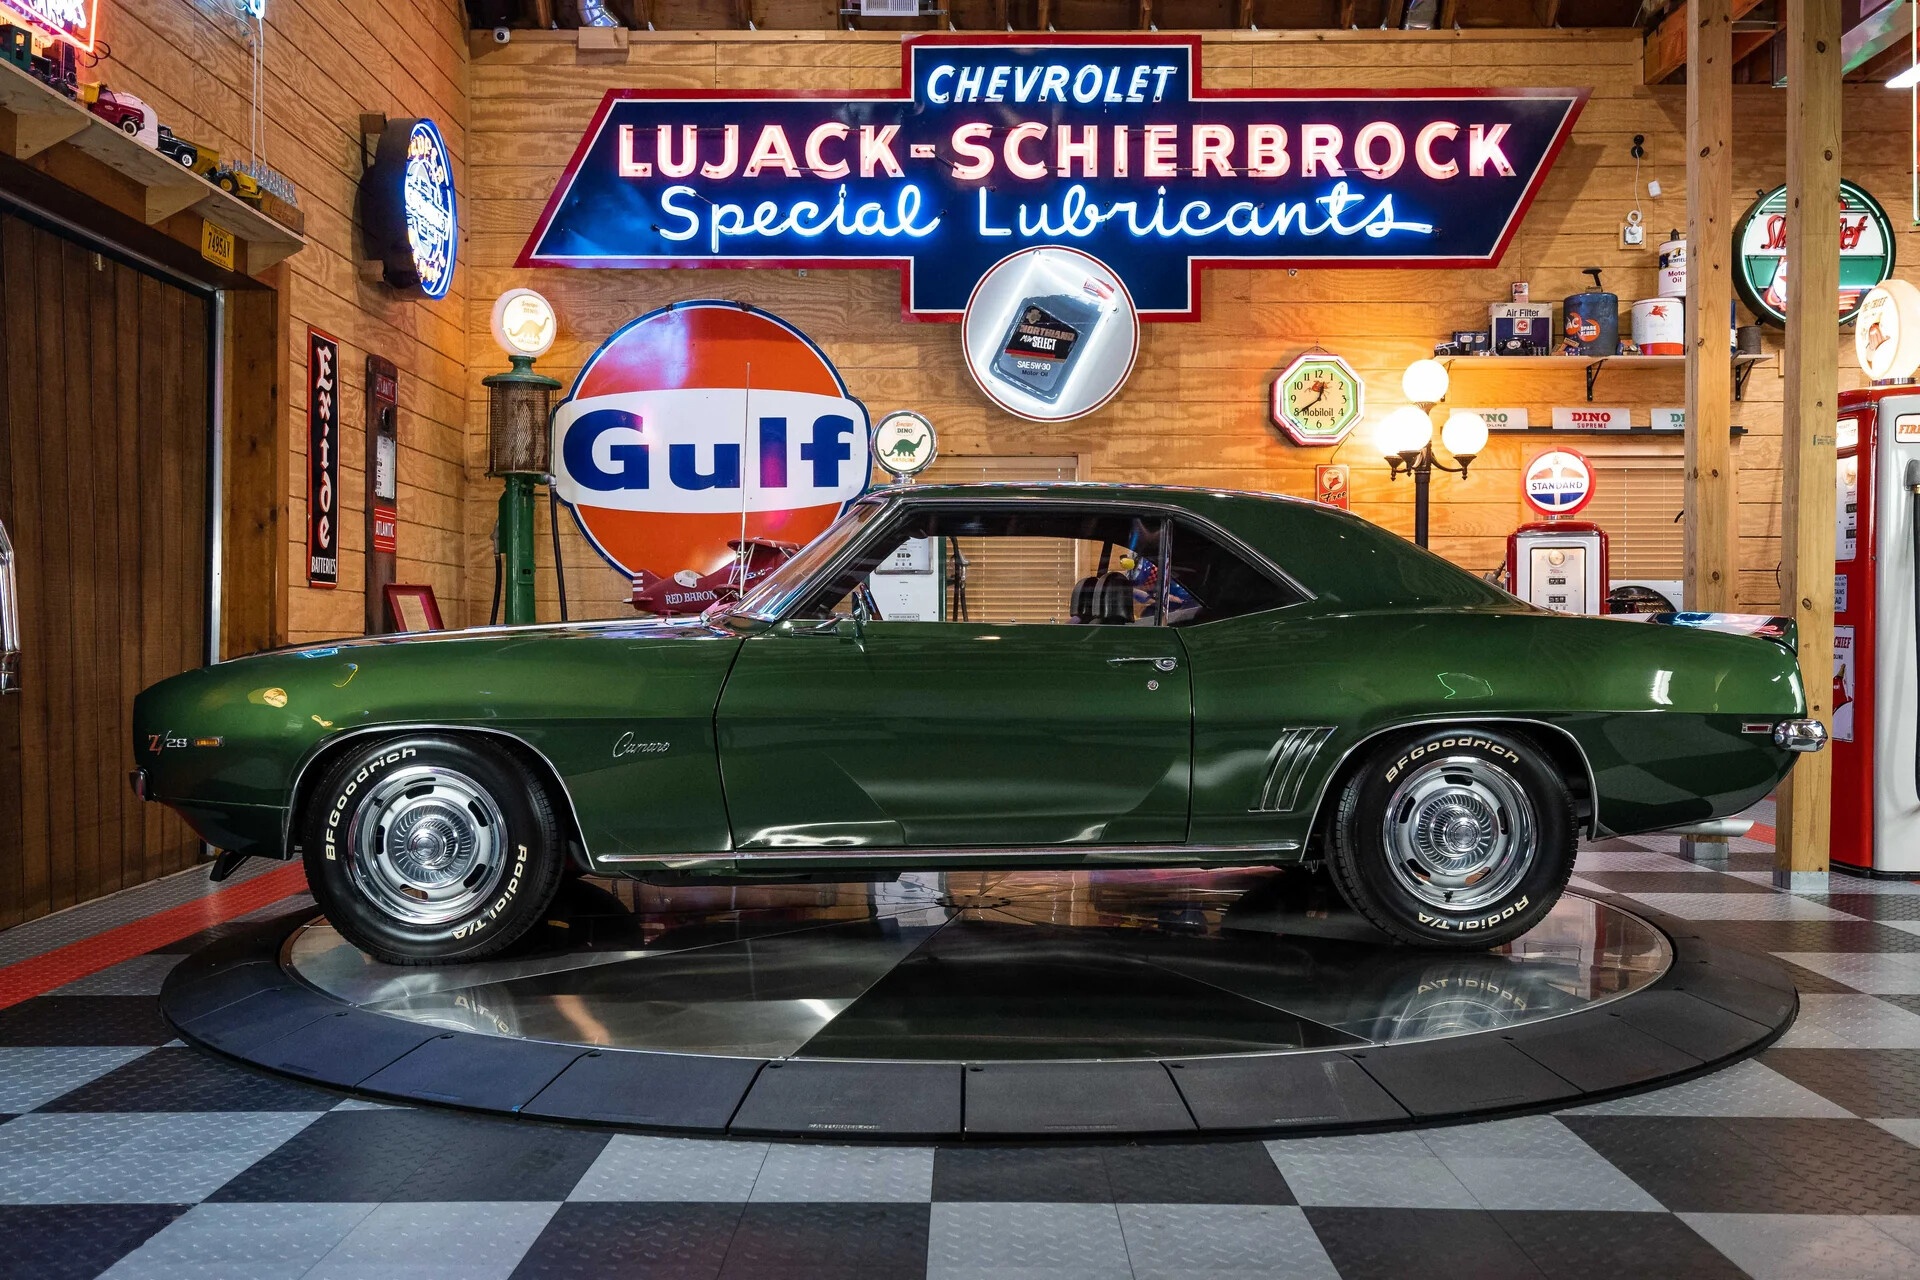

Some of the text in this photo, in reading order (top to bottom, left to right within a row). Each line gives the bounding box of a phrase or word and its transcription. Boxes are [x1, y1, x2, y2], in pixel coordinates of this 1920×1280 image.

[926, 63, 1178, 103] CHEVROLET
[617, 121, 1517, 181] LUJACK-SCHIERBROCK
[658, 181, 1433, 254] Special Lubricants
[1506, 308, 1539, 317] Air Filter
[1566, 317, 1579, 330] AC
[1019, 324, 1075, 341] NORTHLAND
[1017, 360, 1030, 369] SAE
[1304, 373, 1310, 381] 11
[1315, 370, 1323, 378] 12
[1294, 381, 1303, 390] 10
[1339, 381, 1344, 390] 2
[1290, 395, 1297, 403] 9
[1341, 395, 1347, 404] 3
[1294, 408, 1300, 416] 8
[1302, 408, 1334, 416] Mobiloil
[1338, 408, 1344, 416] 4
[1571, 412, 1611, 422] DINO
[1303, 418, 1309, 426] 7
[1330, 417, 1336, 426] 5
[1670, 413, 1685, 422] DI
[1316, 420, 1322, 428] 6
[1898, 424, 1920, 434] FIR
[316, 345, 332, 549] Exide
[563, 408, 854, 492] Gulf
[1532, 481, 1583, 491] STANDARD
[1320, 491, 1347, 502] Free
[375, 520, 394, 538] ATLANTIC
[311, 556, 336, 575] BATTERIES
[665, 590, 718, 605] RED BARON
[1834, 636, 1852, 649] CHIEF
[148, 730, 188, 755] Z/28
[612, 731, 671, 758] Camaro
[1385, 736, 1520, 784] BFGoodrich
[325, 746, 418, 861] BFGoodrich
[451, 844, 528, 941] Radial T/A
[1418, 894, 1530, 931] Radial T/A
